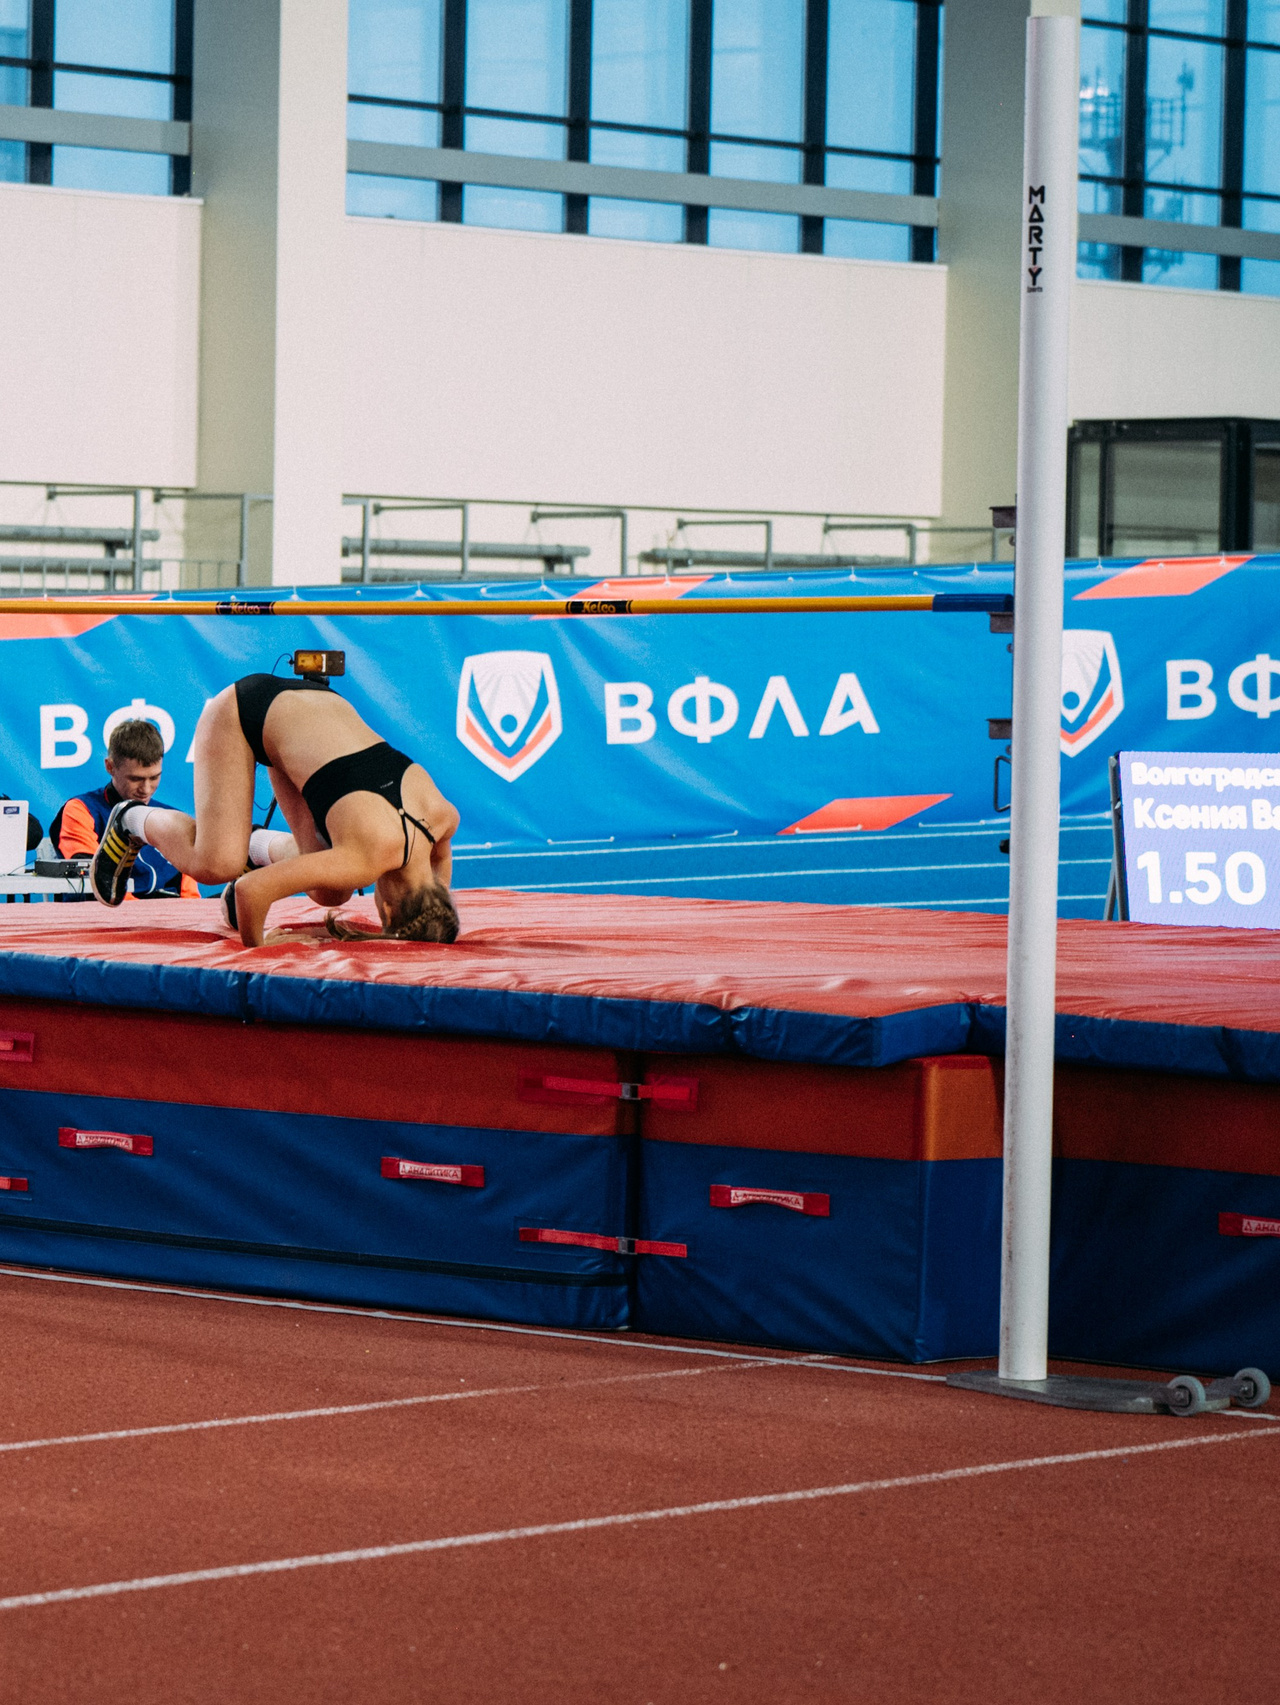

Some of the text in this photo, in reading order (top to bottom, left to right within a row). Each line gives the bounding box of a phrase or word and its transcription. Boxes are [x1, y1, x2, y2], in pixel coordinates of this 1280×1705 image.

[1028, 185, 1045, 286] MARTY
[604, 673, 881, 745] ВФЛА
[1133, 798, 1248, 830] Ксения
[1137, 851, 1266, 905] 1.50
